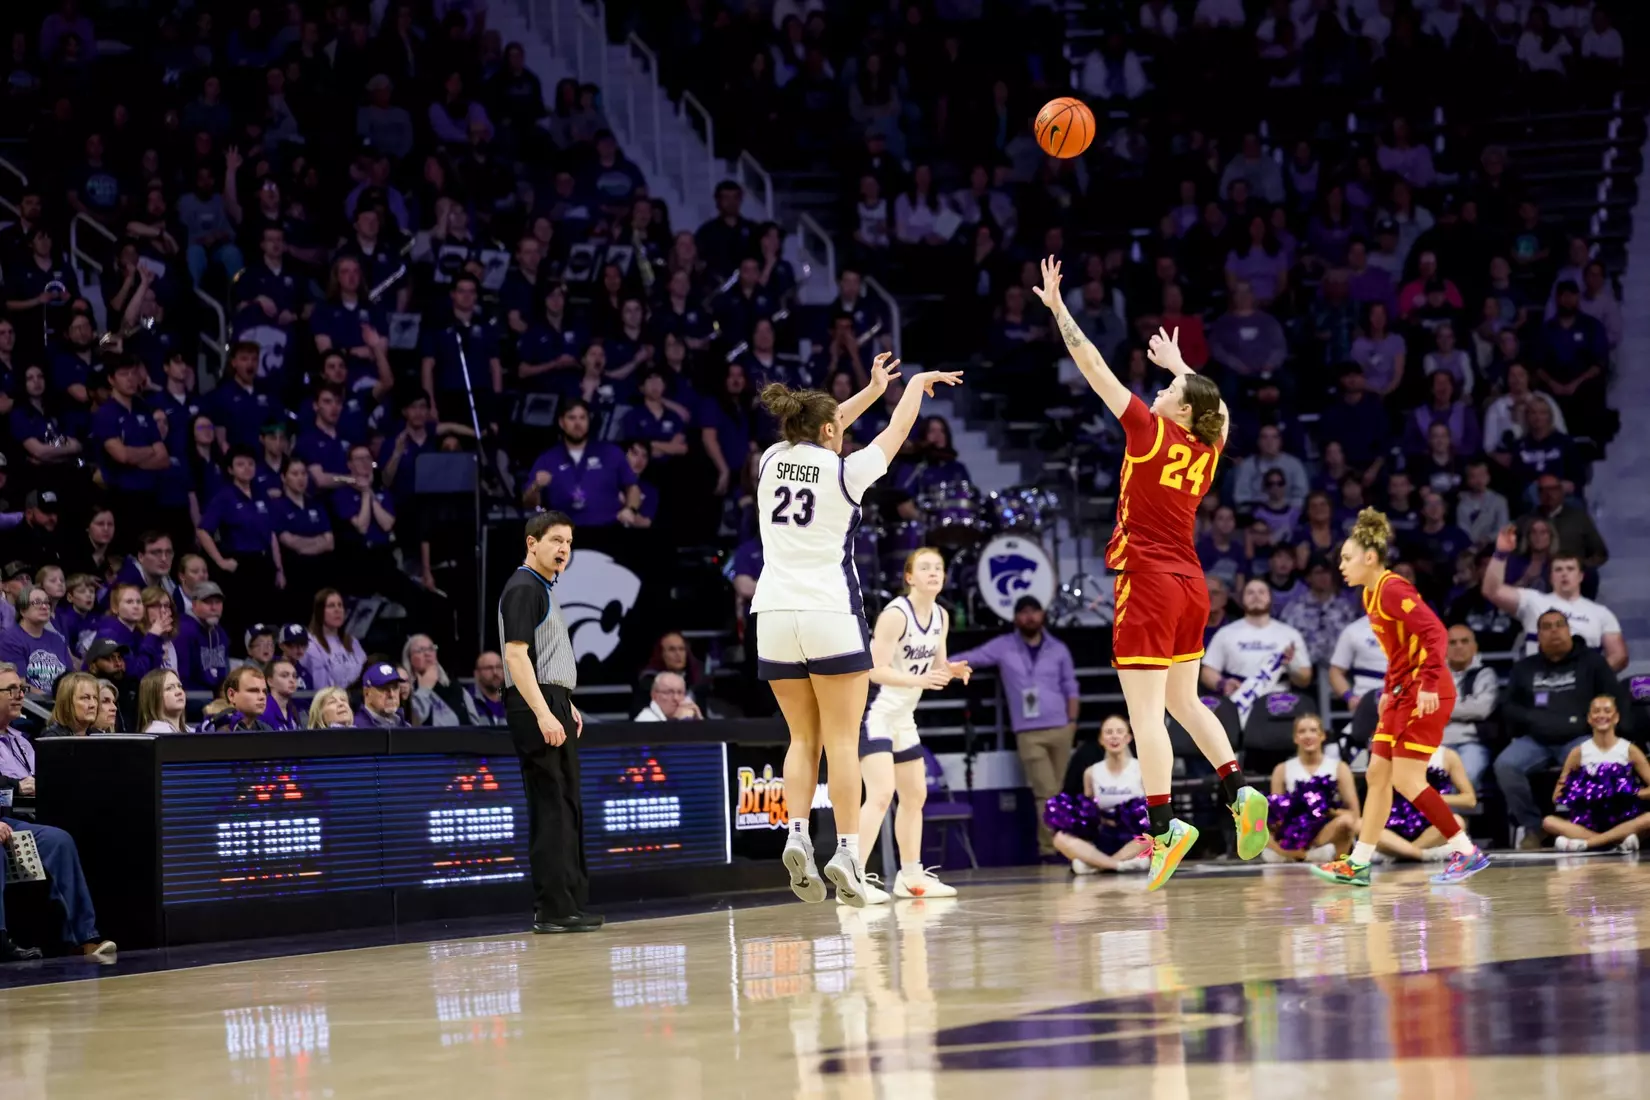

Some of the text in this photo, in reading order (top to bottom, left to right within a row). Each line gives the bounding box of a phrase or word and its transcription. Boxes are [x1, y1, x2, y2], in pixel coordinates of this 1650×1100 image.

[776, 461, 820, 484] SPEISER
[1159, 443, 1211, 496] 24
[771, 485, 816, 528] 23
[903, 644, 936, 660] Wildca
[738, 763, 789, 827] Brigg
